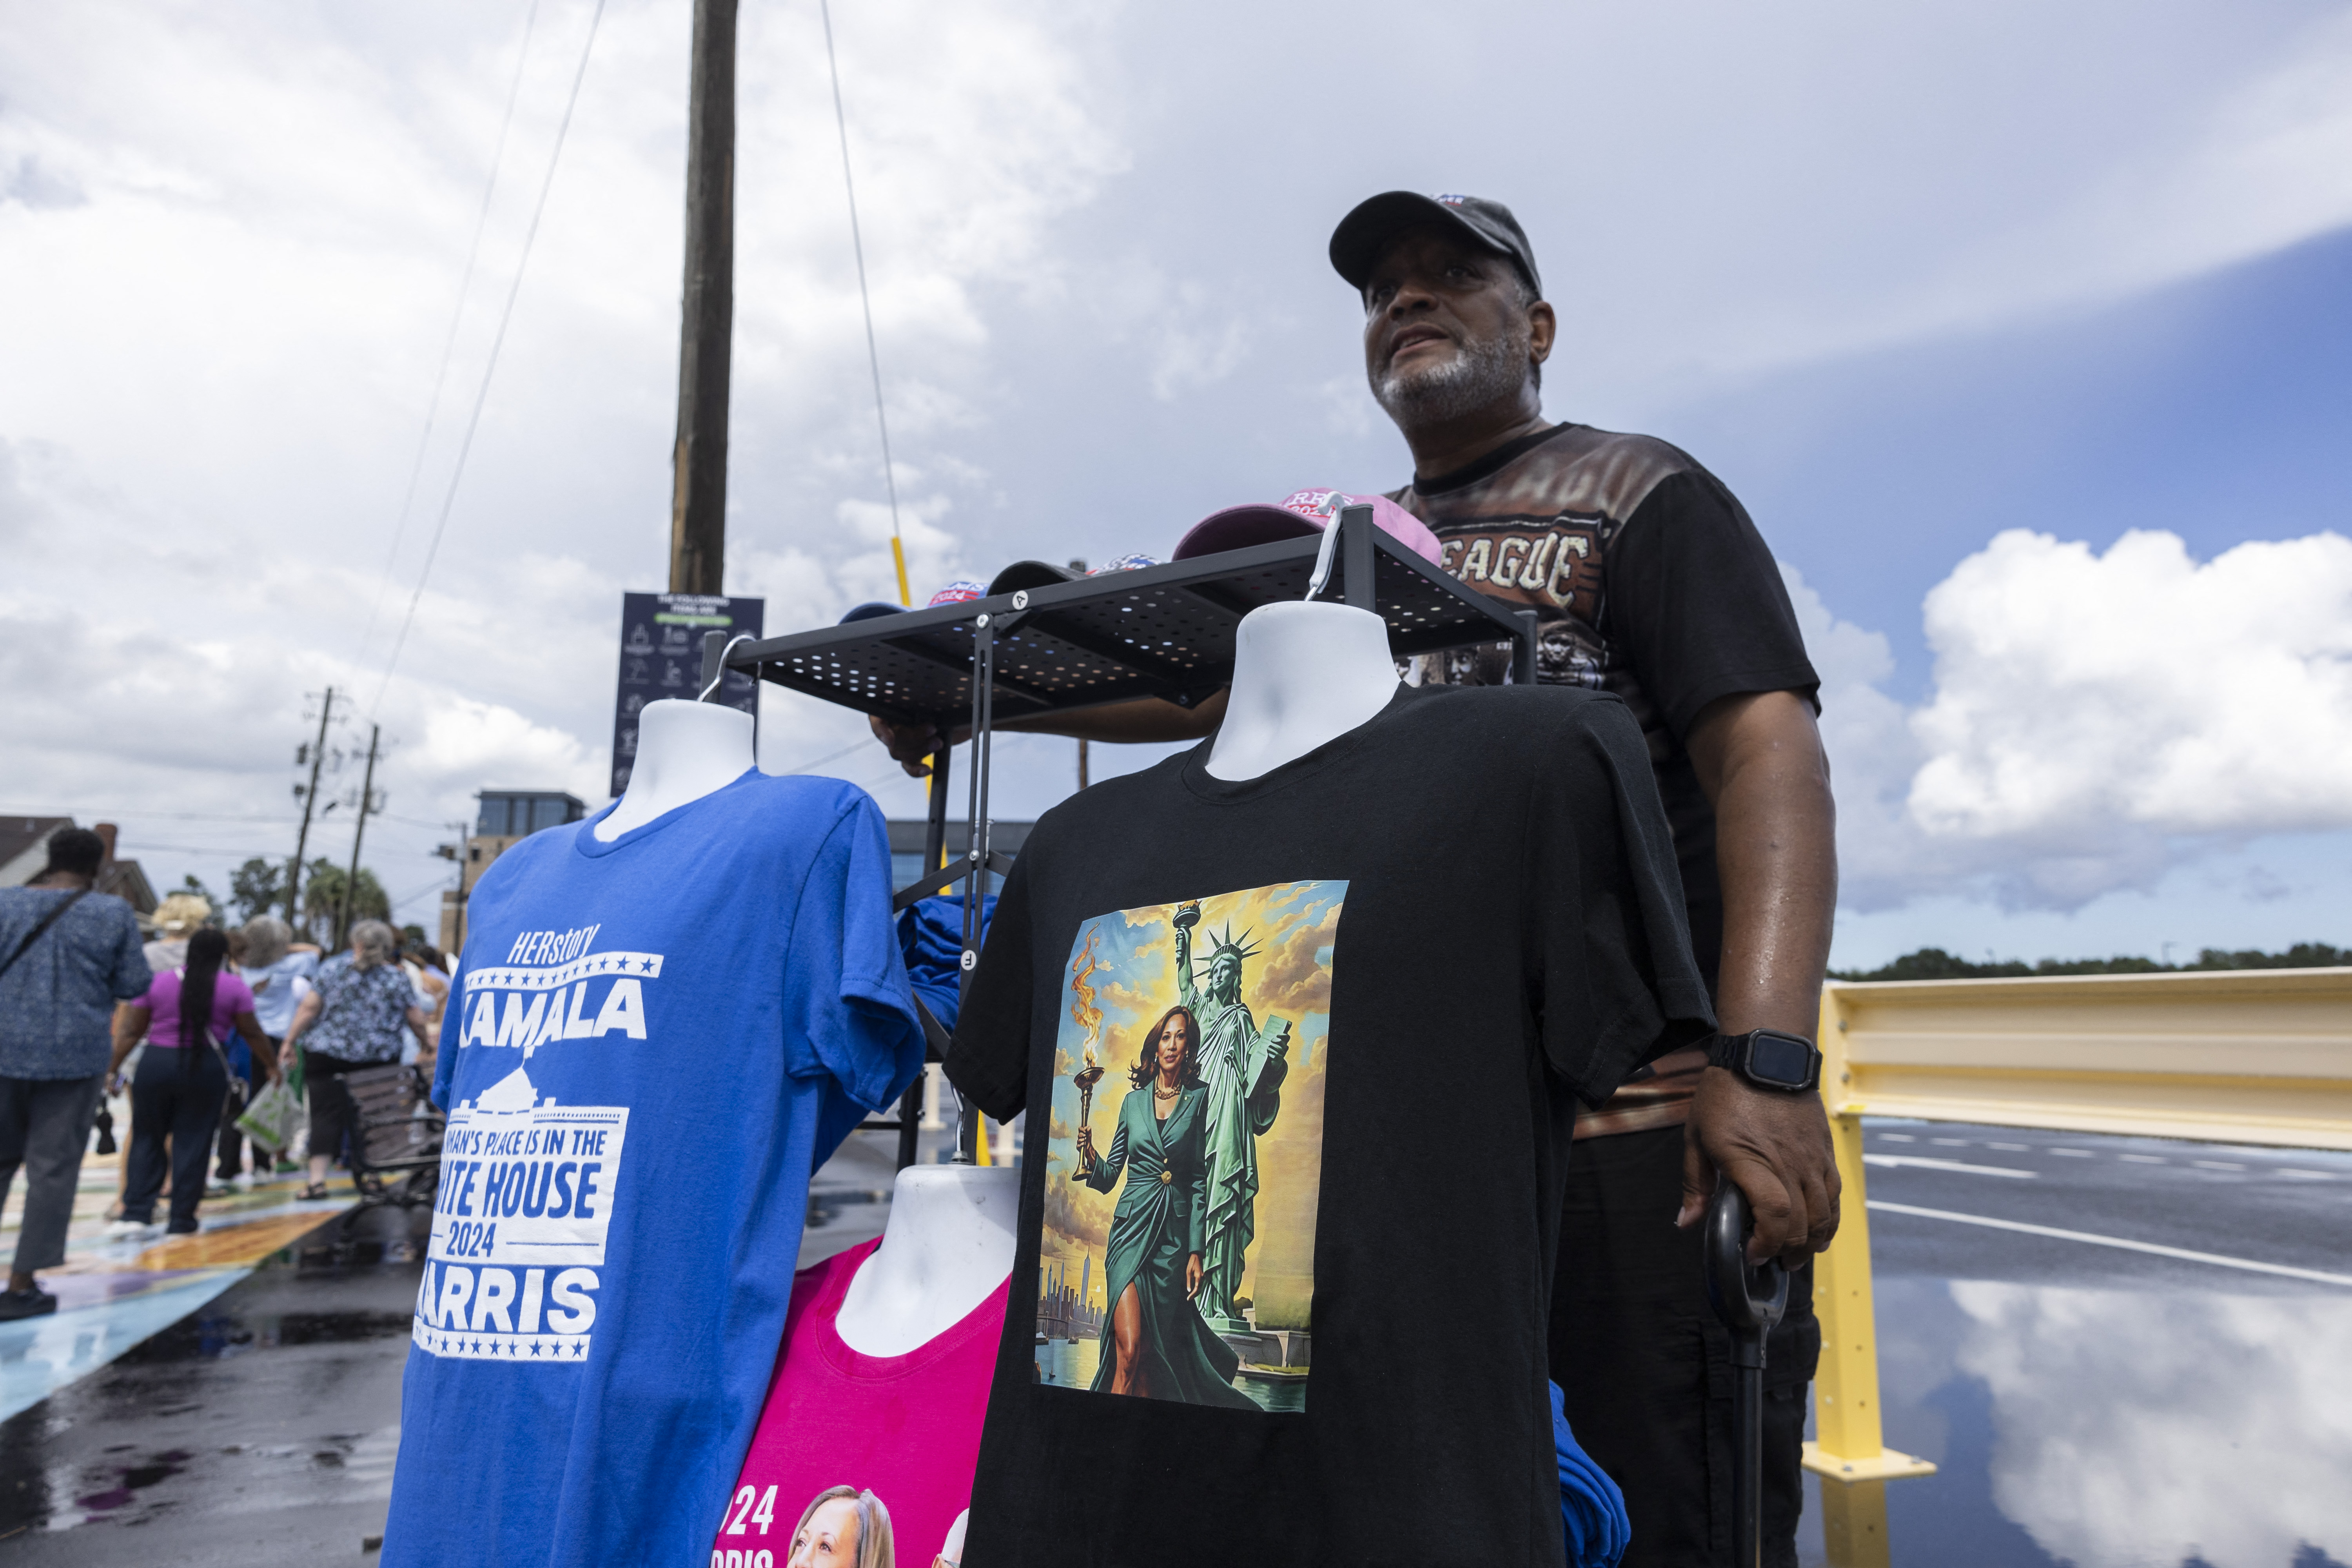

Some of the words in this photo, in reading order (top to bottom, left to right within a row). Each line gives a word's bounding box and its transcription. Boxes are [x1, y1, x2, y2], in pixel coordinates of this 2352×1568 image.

[1441, 532, 1588, 607] EAGUE
[1017, 595, 1025, 606] A
[506, 923, 601, 965] HERstory
[484, 1129, 524, 1156] PLACE
[524, 1129, 541, 1156] IS
[542, 1129, 566, 1156] IN
[572, 1129, 608, 1156] THE
[482, 1161, 602, 1219] HOUSE
[446, 1220, 497, 1258] 2024
[719, 1485, 779, 1535] 24
